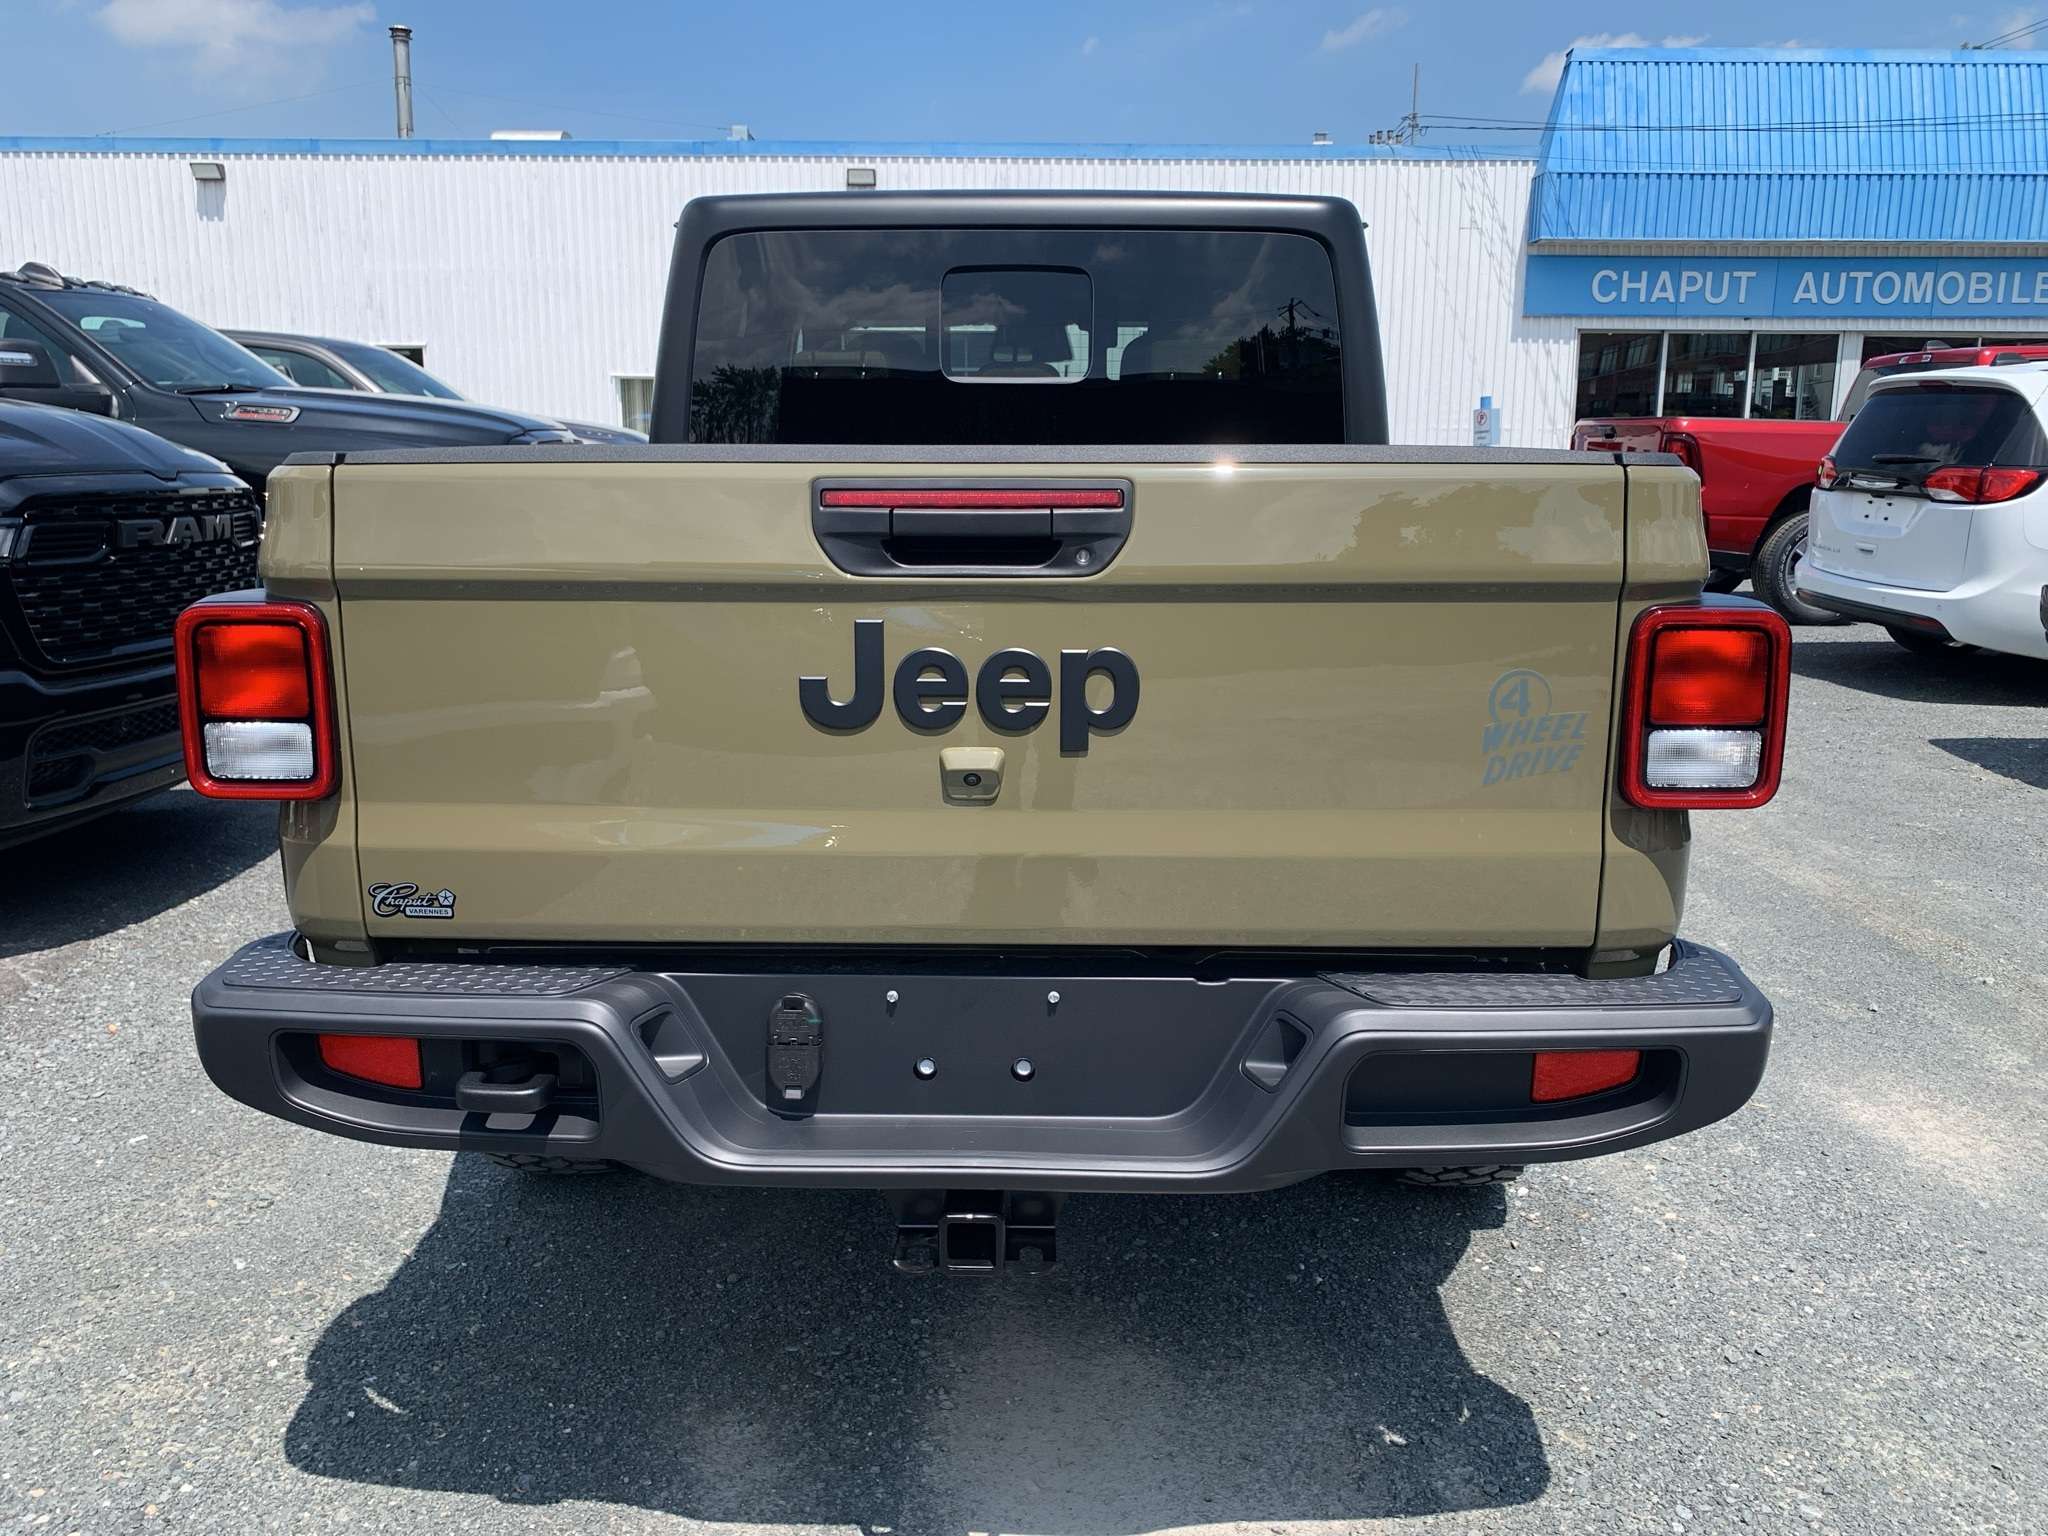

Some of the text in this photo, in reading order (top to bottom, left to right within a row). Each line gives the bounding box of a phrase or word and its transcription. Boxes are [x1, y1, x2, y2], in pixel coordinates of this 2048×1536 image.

[1591, 269, 1757, 305] CHAPUT
[117, 514, 232, 548] RAM
[799, 618, 1140, 757] Jeep
[1501, 680, 1529, 717] 4
[1482, 712, 1589, 753] WHEEL
[1482, 744, 1585, 785] DRIVE
[368, 882, 437, 916] Chaput
[408, 907, 450, 916] VARENNES
